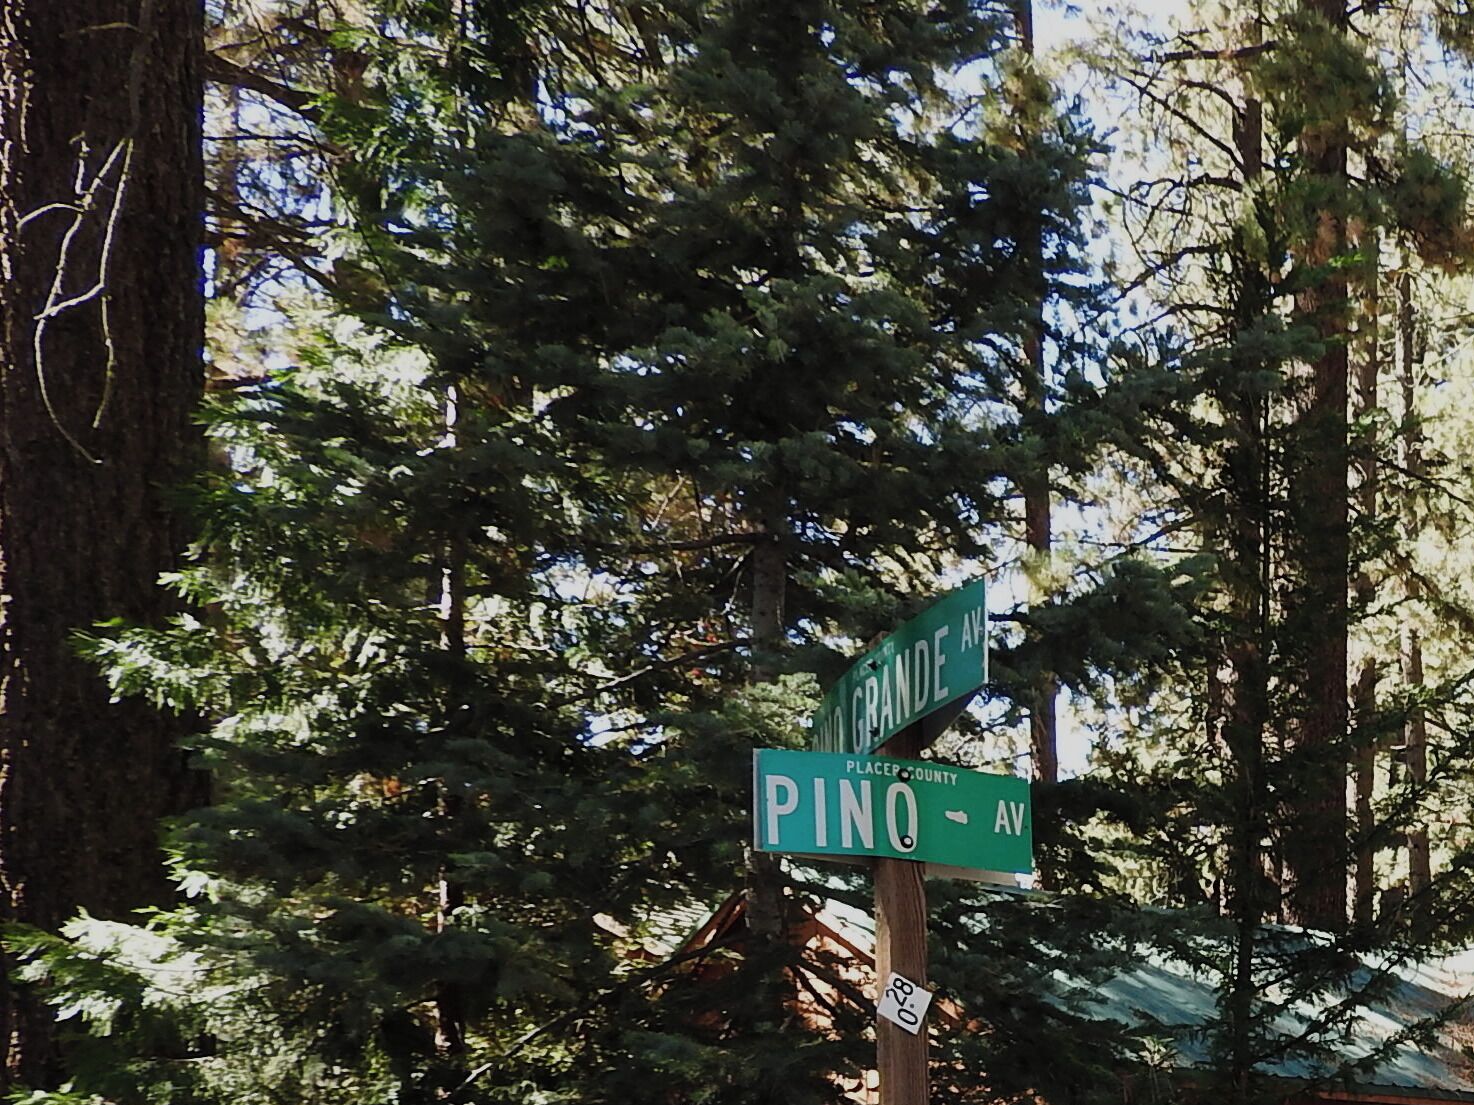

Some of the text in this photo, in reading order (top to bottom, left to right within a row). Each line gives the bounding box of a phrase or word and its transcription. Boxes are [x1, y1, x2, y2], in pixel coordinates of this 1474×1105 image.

[852, 625, 949, 753] GRANDE
[961, 605, 983, 653] AV
[846, 760, 957, 786] PLACER COUNTY
[765, 774, 1025, 853] PINO AV
